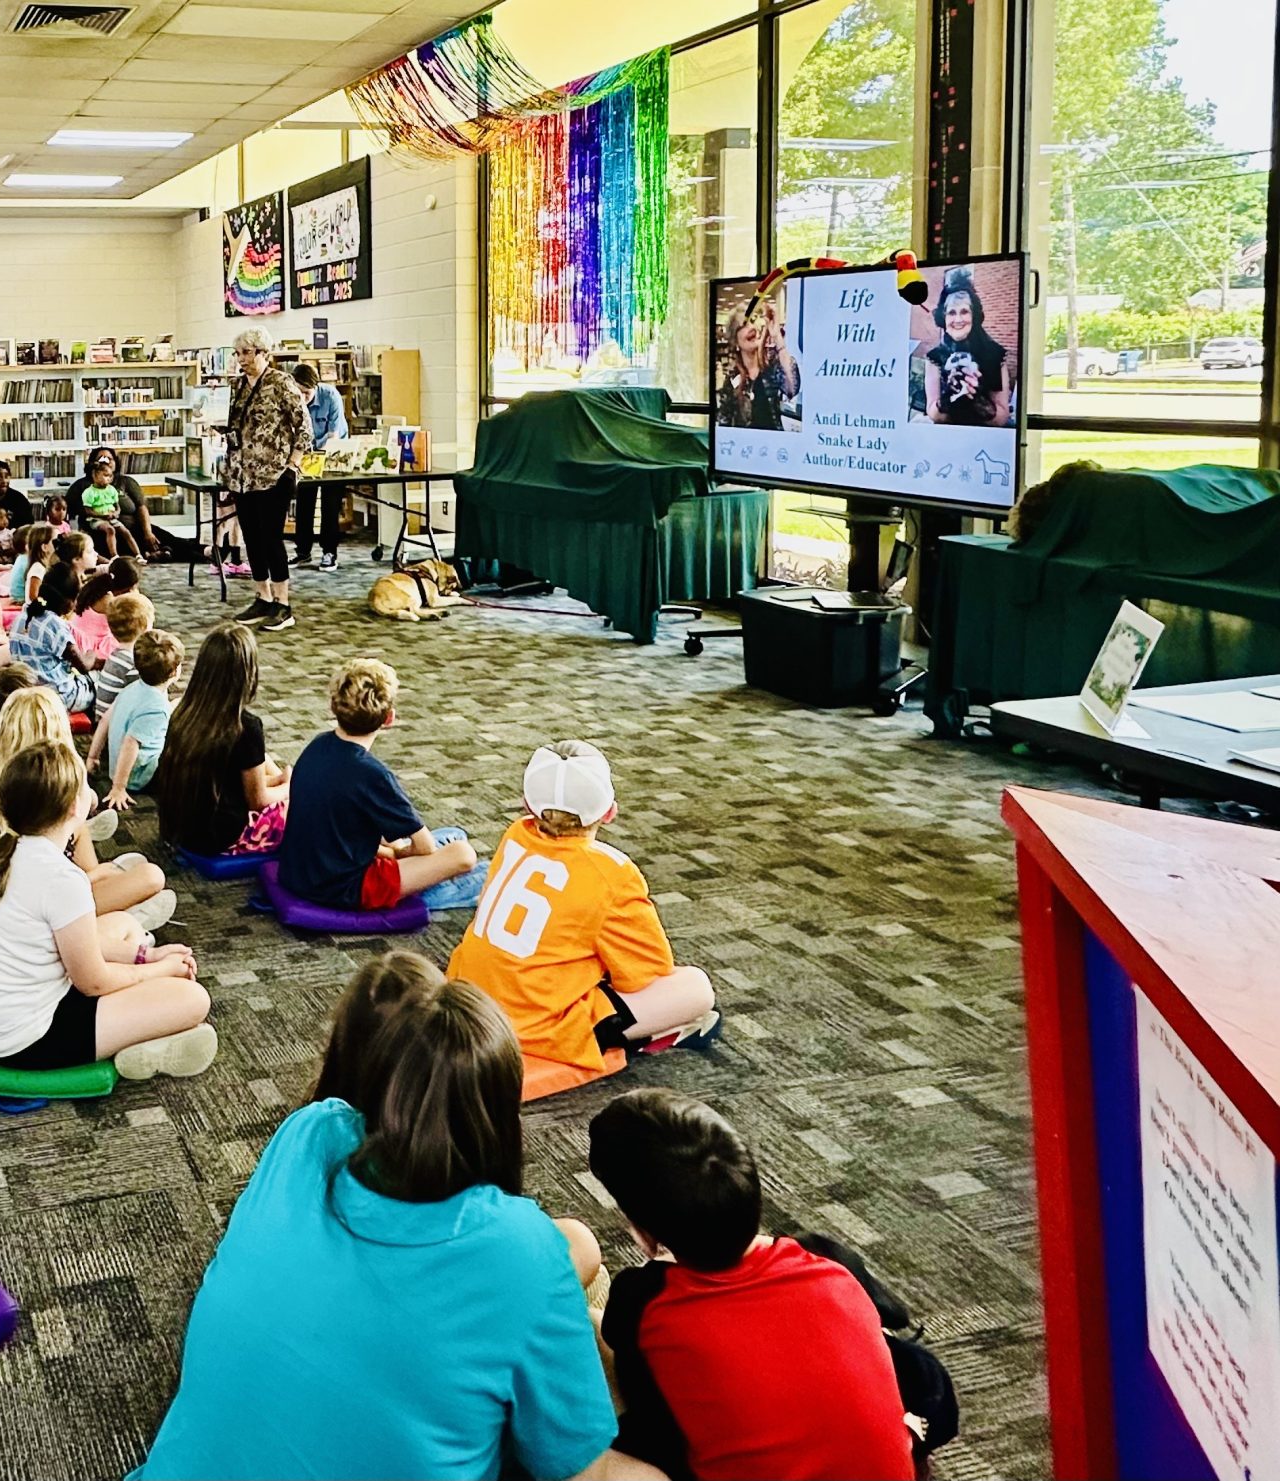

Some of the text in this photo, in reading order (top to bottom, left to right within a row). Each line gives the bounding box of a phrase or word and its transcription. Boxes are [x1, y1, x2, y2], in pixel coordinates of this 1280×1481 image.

[334, 280, 353, 300] 2025
[838, 288, 875, 313] Life
[837, 323, 876, 343] With
[815, 358, 896, 378] Animals!
[812, 412, 896, 429] Andi Lehman
[817, 432, 890, 455] Snake Lady
[802, 451, 908, 475] Author/Educator
[473, 838, 570, 959] 16
